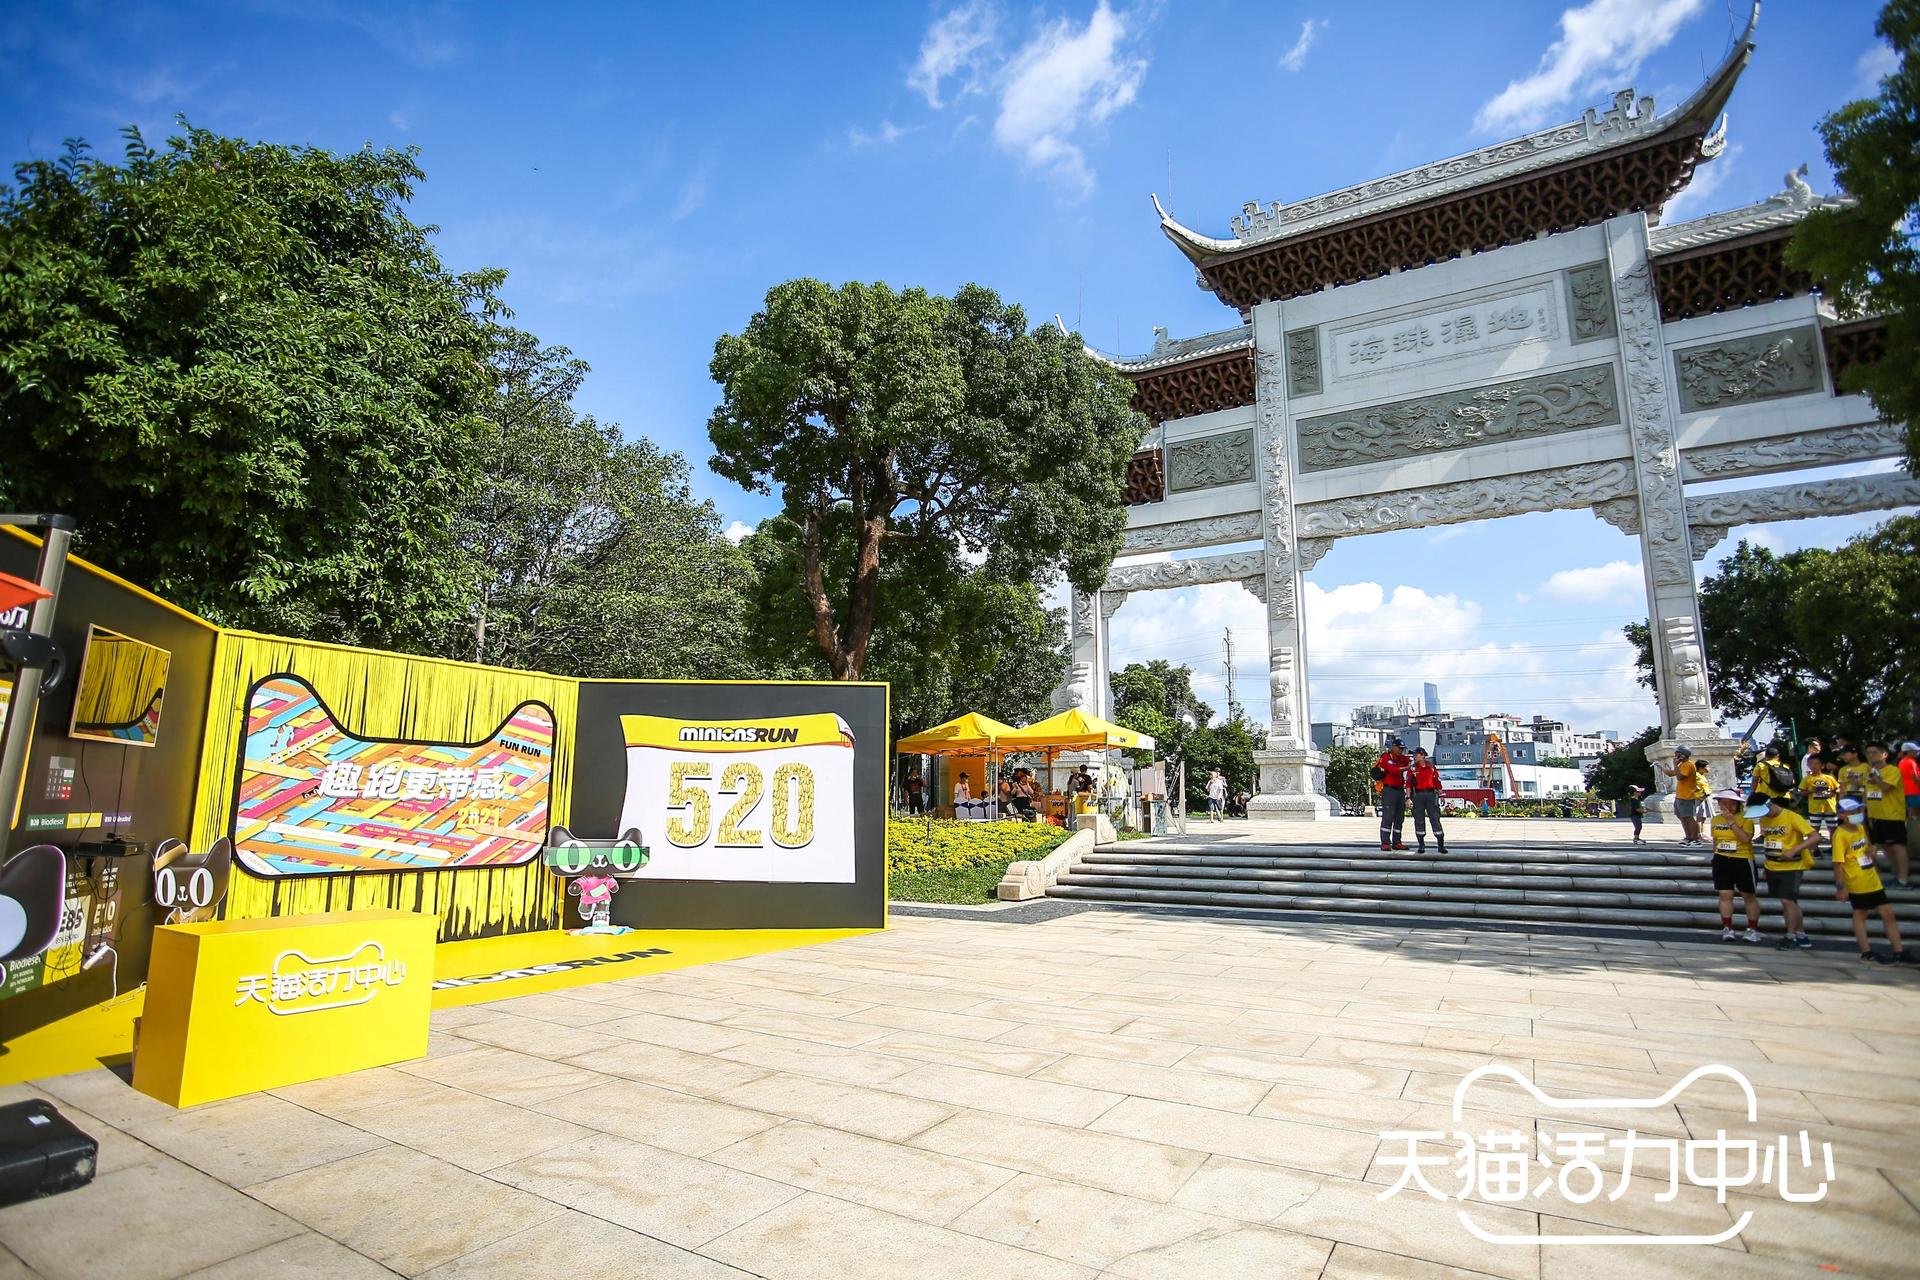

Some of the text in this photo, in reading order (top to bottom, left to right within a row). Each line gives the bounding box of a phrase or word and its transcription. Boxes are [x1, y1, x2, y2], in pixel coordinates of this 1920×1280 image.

[499, 738, 542, 758] FUN RUN
[318, 759, 508, 801] 趣跑更带感
[456, 806, 500, 829] 2021
[665, 761, 817, 849] 520
[9, 955, 41, 972] Biodiesel
[235, 959, 406, 1007] 天猫活力中心
